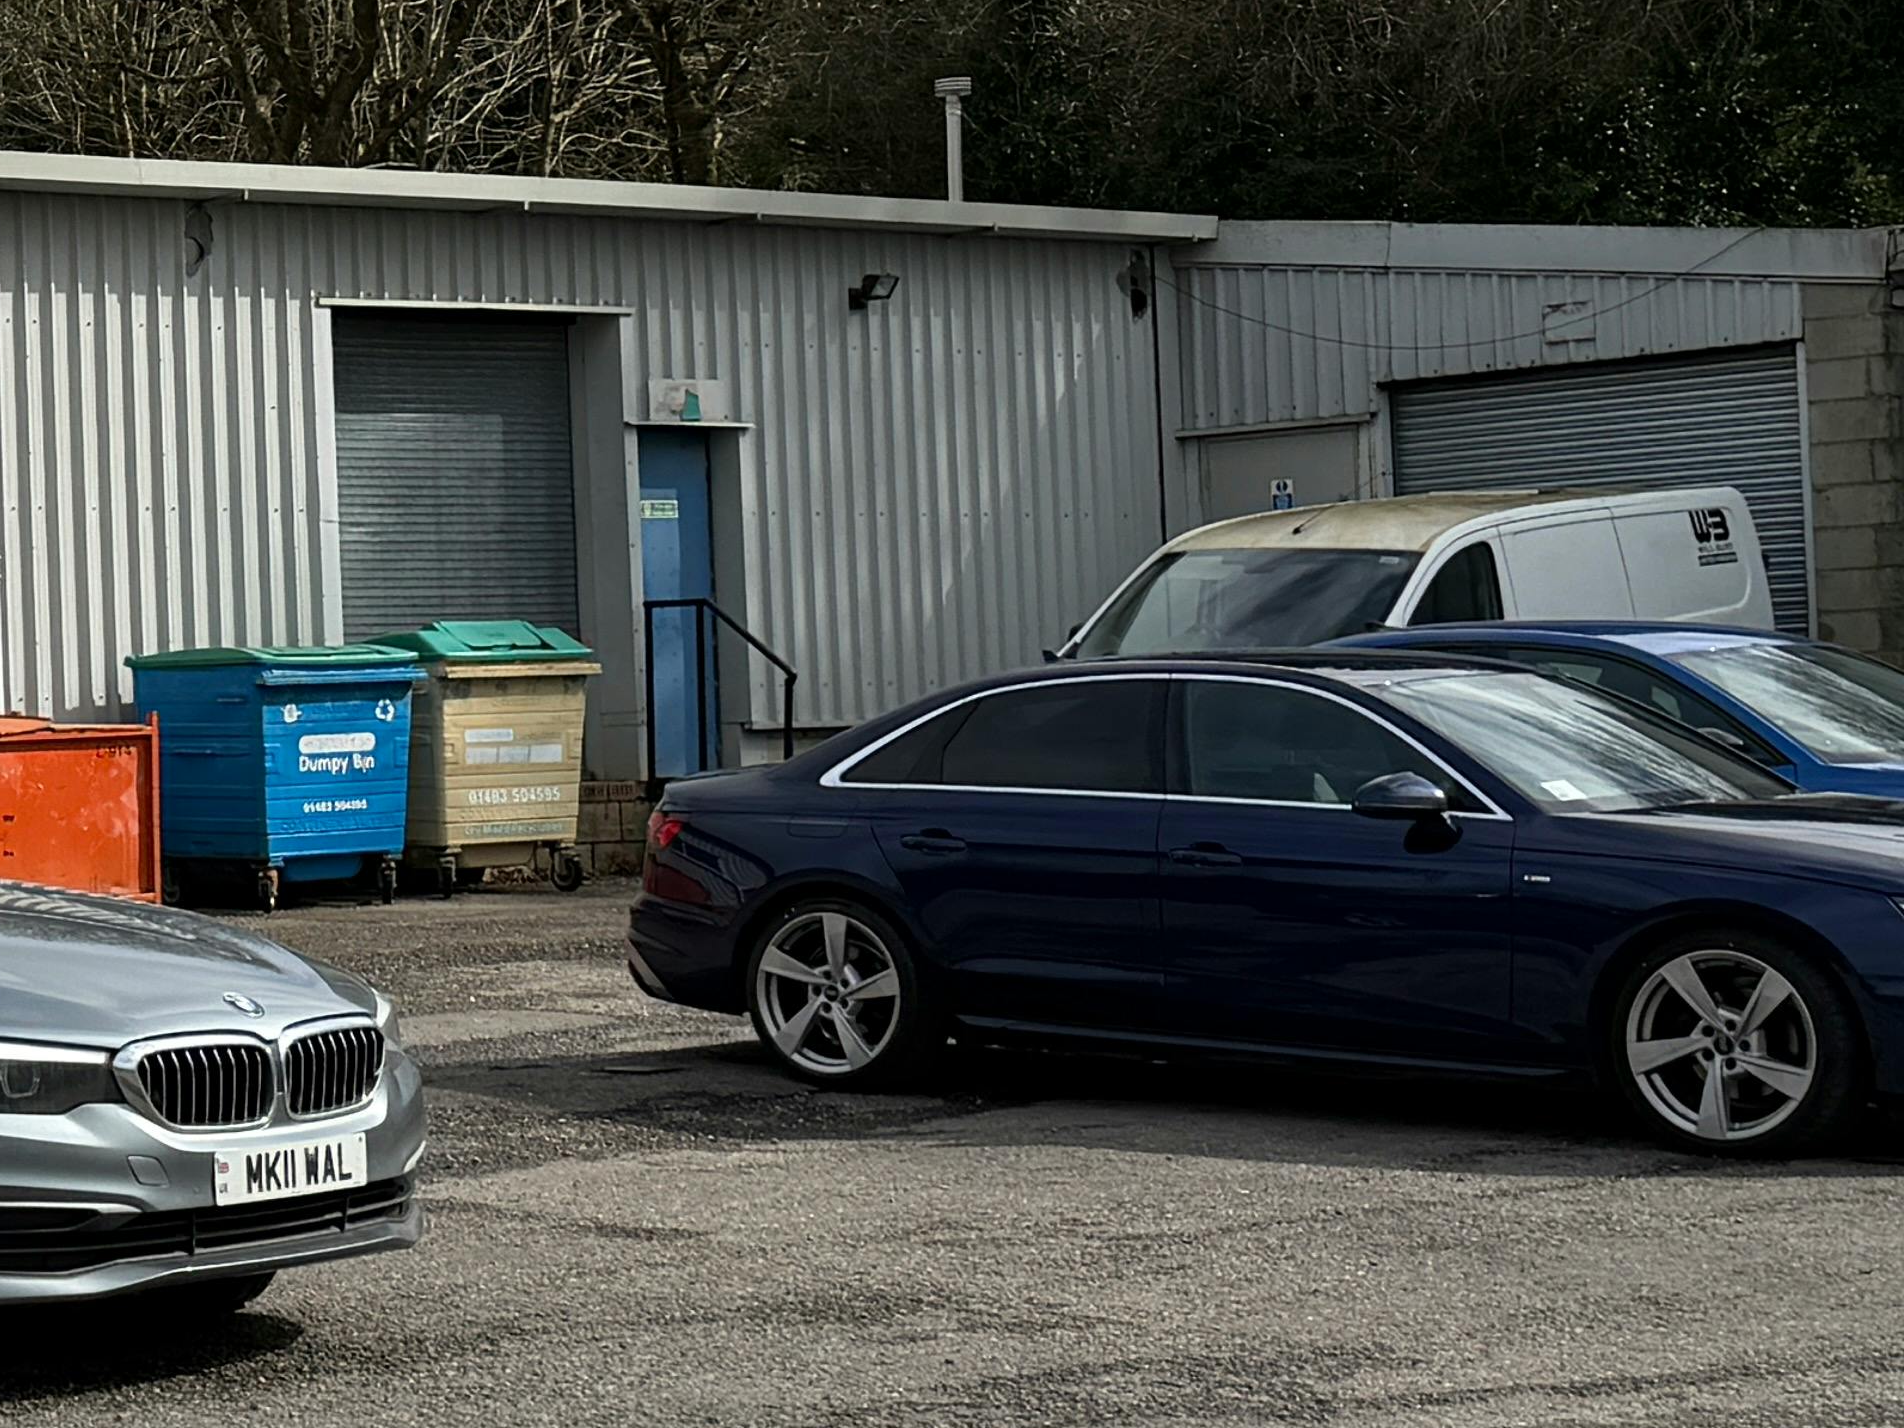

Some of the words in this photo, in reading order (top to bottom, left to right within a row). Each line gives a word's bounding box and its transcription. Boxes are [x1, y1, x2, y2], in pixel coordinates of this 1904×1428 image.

[298, 756, 349, 775] Dumpy
[246, 1149, 296, 1194] MK11
[304, 1142, 353, 1185] WAL
